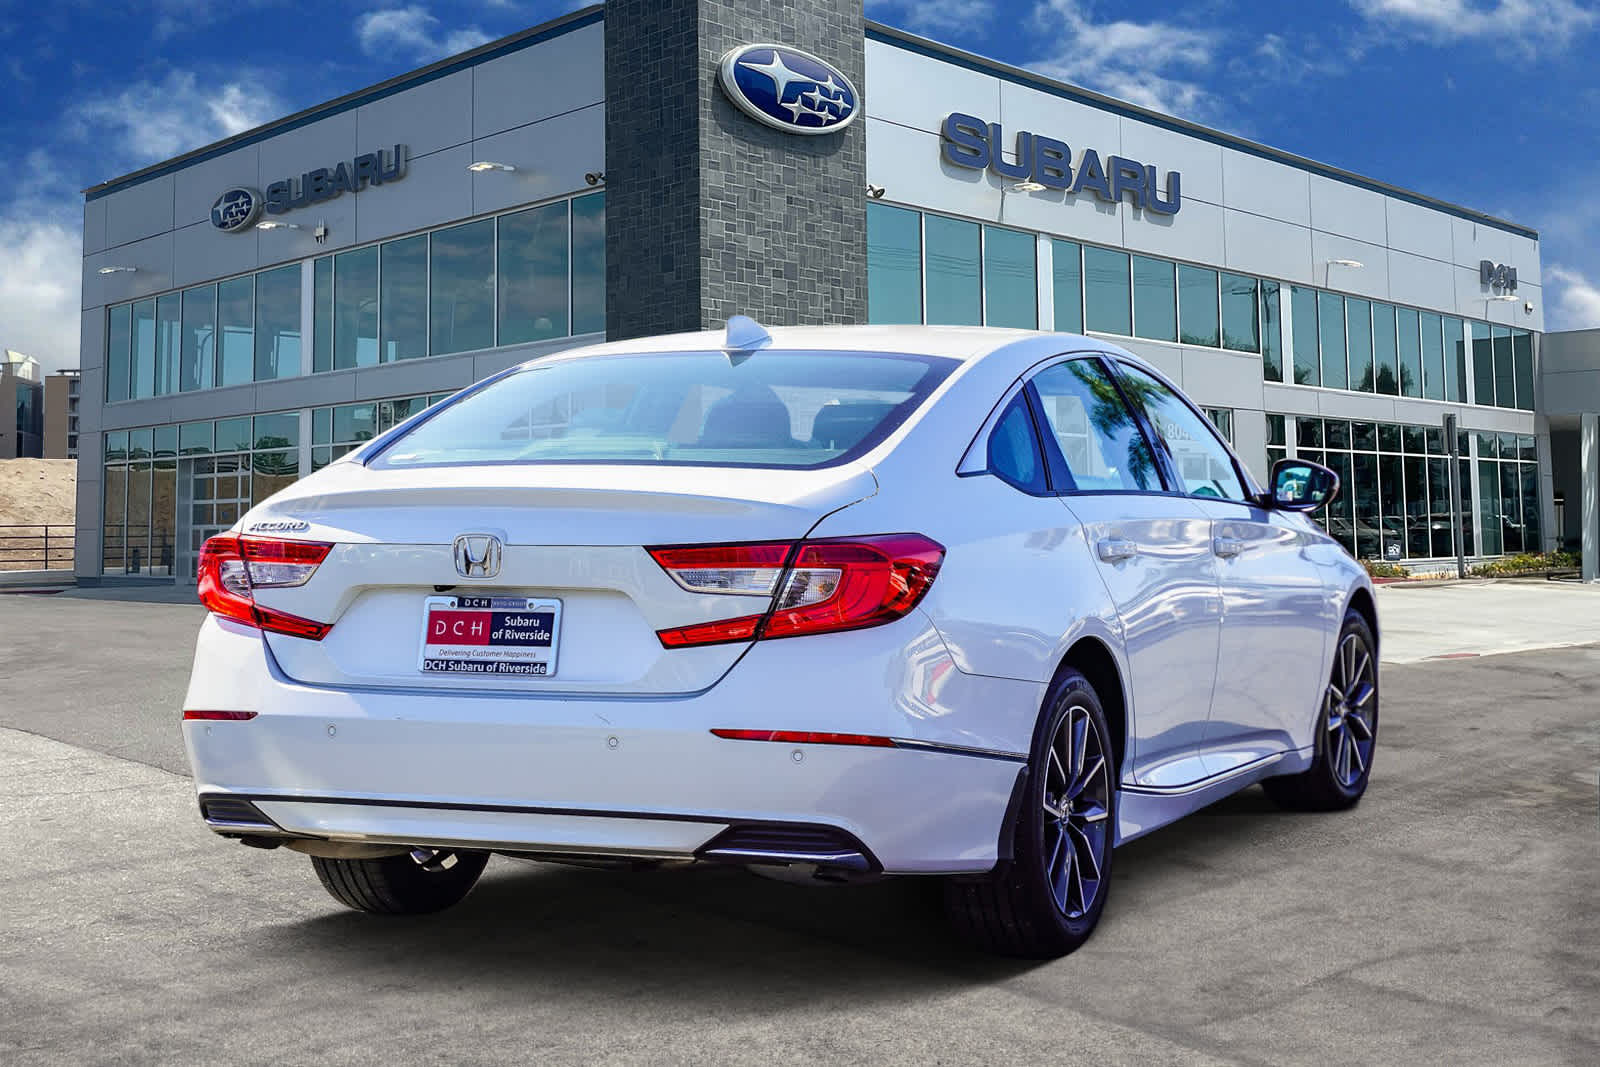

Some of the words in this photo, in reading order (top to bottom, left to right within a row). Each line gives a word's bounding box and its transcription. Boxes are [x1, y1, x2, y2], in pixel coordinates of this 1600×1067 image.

[941, 112, 1181, 215] SUBARU
[266, 144, 405, 215] SUBARU
[249, 522, 309, 533] ACCORD
[504, 616, 540, 627] Subaru
[492, 629, 503, 640] of
[505, 630, 550, 641] Riverside
[439, 649, 471, 658] Delivering
[472, 650, 503, 658] Customer
[503, 650, 536, 659] Happiness
[424, 660, 447, 670] DCH
[448, 660, 484, 672] Subaru
[486, 662, 498, 672] of
[499, 663, 546, 674] Riverside
